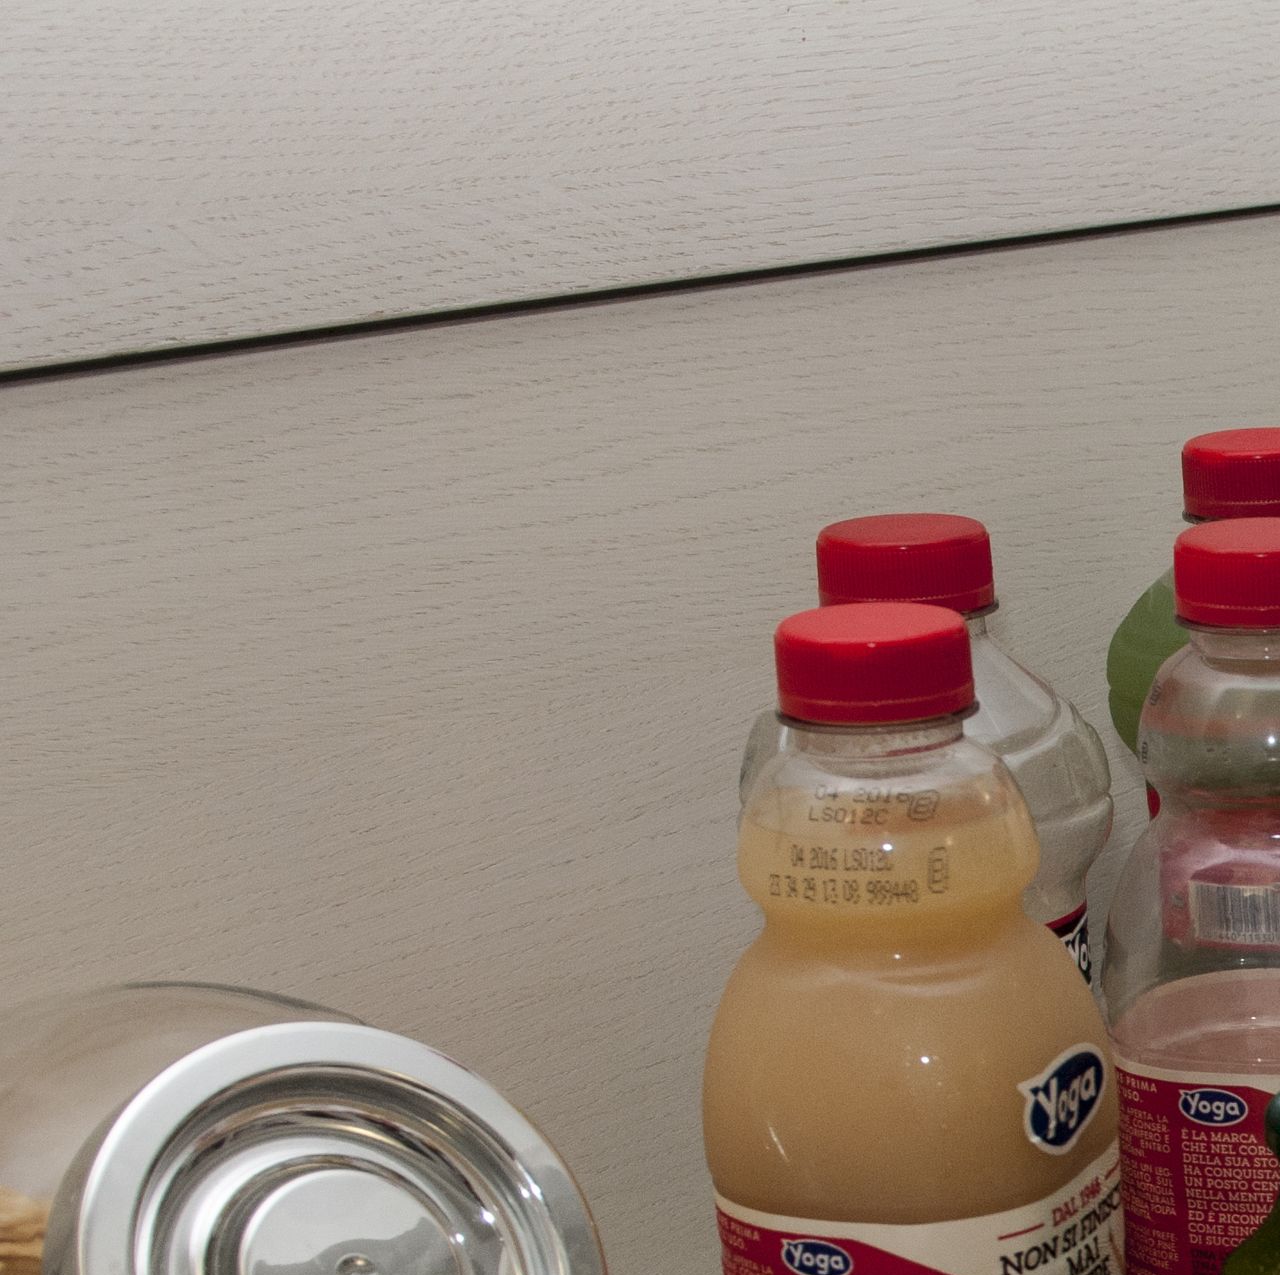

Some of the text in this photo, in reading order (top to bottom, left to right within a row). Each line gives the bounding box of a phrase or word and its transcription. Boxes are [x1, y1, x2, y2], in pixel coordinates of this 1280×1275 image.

[1036, 1064, 1099, 1141] Yoga
[1186, 1092, 1242, 1121] Yoga
[1192, 1131, 1208, 1141] LA
[1210, 1132, 1258, 1145] MARCA
[1182, 1142, 1275, 1157] CHE NEL CORS
[1183, 1153, 1222, 1166] DELLA
[1224, 1156, 1250, 1168] SUA
[1184, 1164, 1202, 1175] HA
[1184, 1175, 1203, 1187] UN
[1206, 1178, 1249, 1191] POSTO
[1186, 1187, 1274, 1204] NELLA MENTE
[1051, 1195, 1079, 1228] DAL
[1187, 1197, 1273, 1214] DEI CONSUM
[1188, 1208, 1205, 1221] ED
[1218, 1212, 1269, 1225] RICON
[1188, 1221, 1226, 1235] COME
[1060, 1223, 1079, 1256] SI
[1190, 1233, 1246, 1248] DI SUCC
[788, 1243, 847, 1275] Yoga
